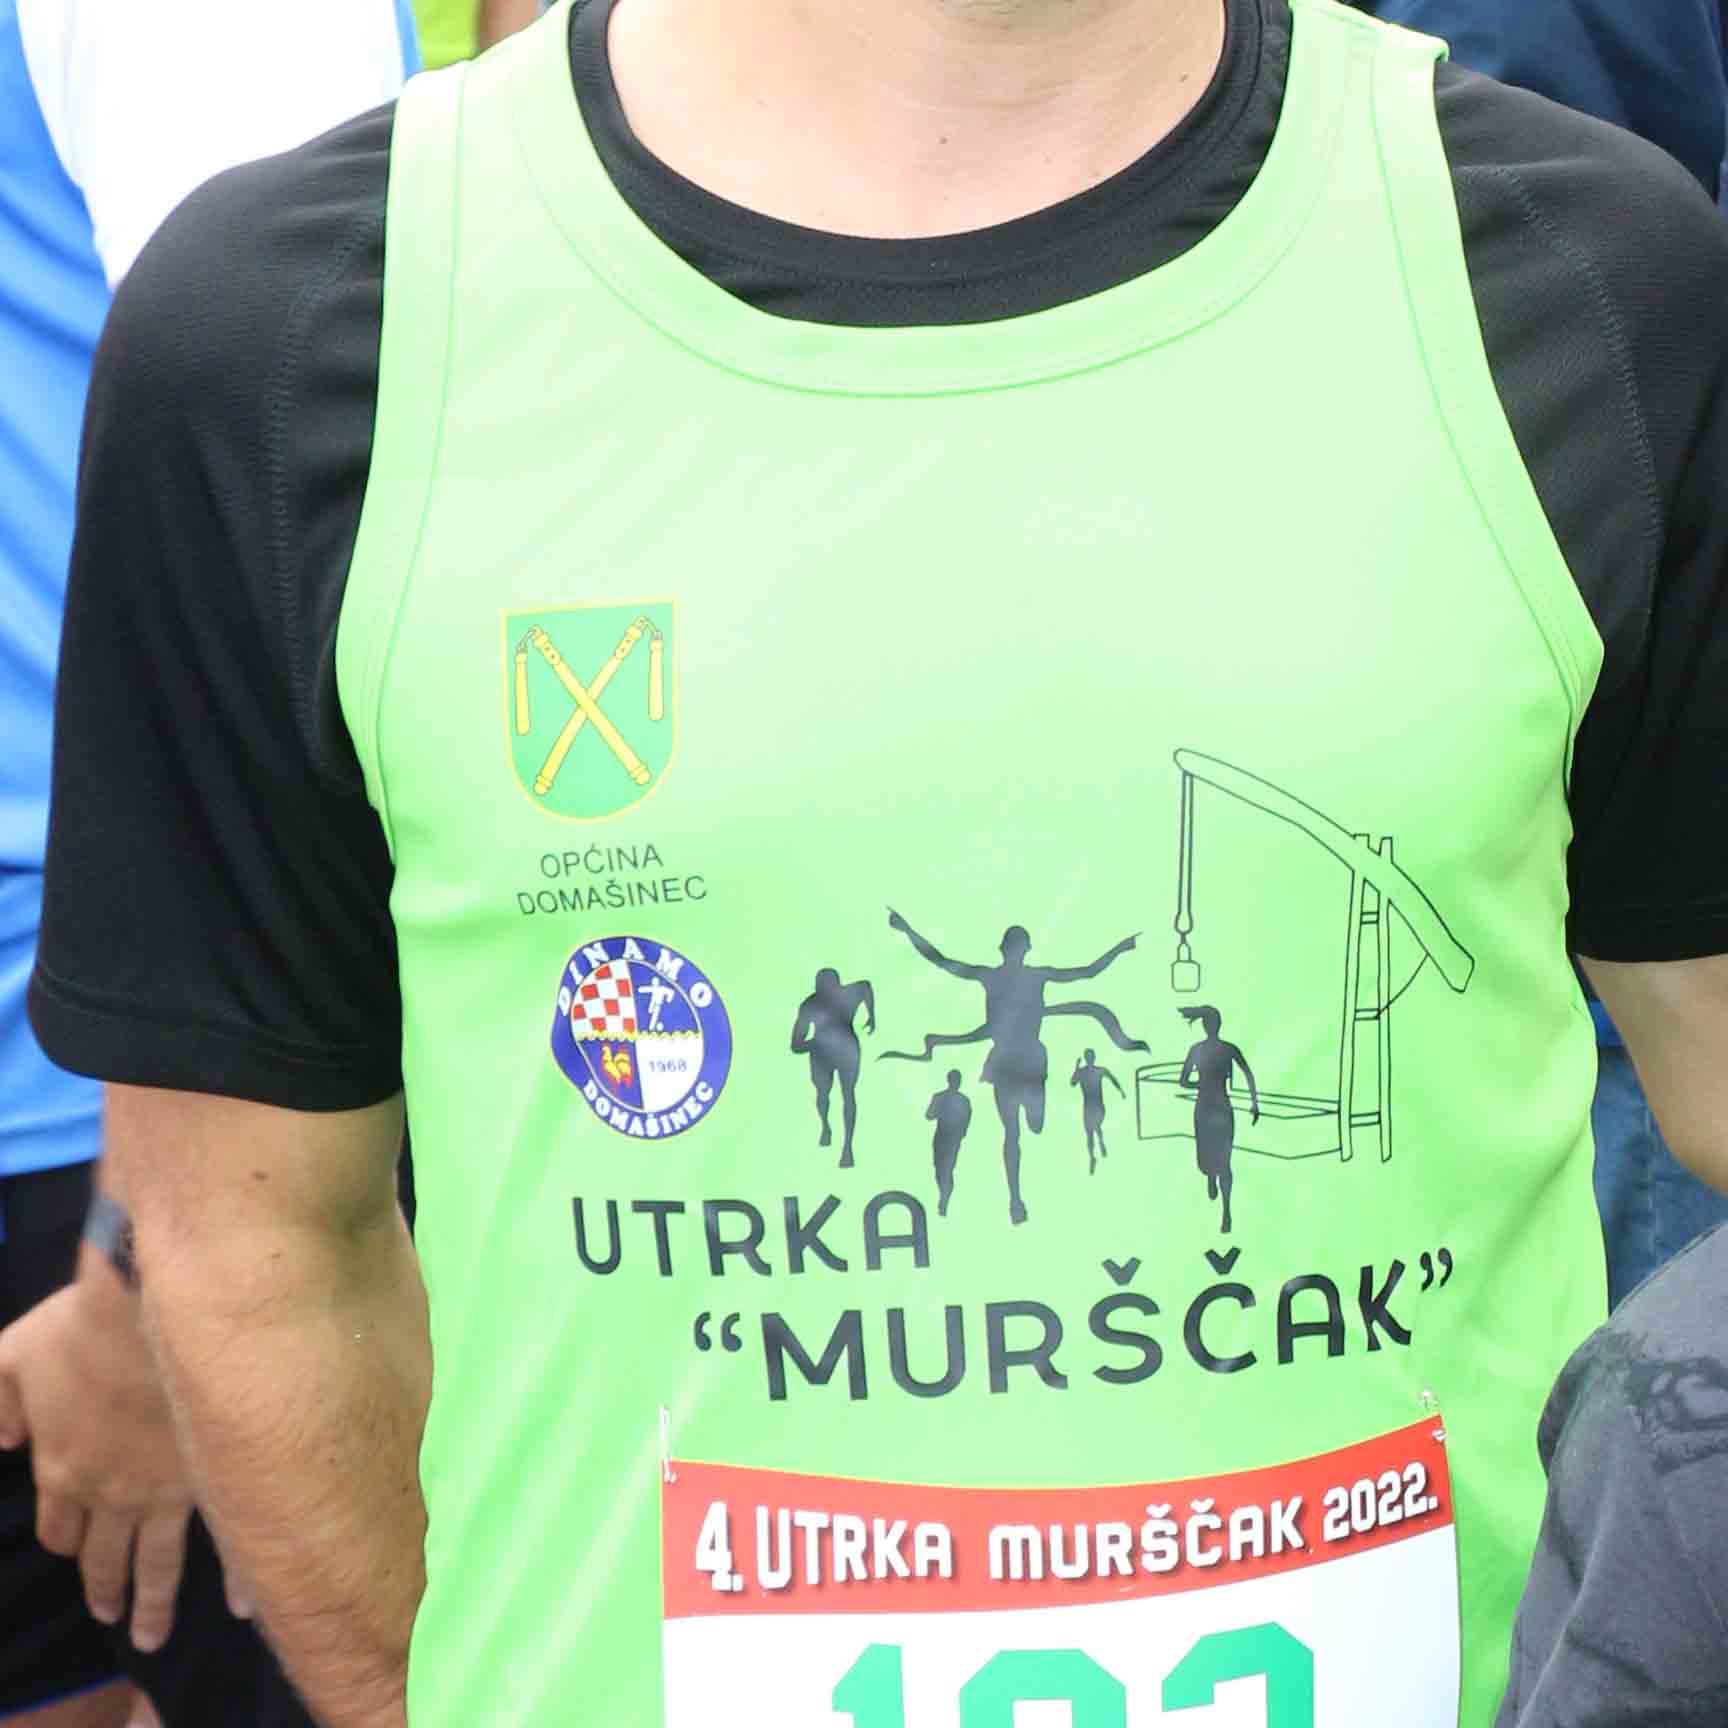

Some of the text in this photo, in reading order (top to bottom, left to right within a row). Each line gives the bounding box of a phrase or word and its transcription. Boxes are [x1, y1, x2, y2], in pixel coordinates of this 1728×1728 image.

[539, 841, 665, 880] OPĆINA
[517, 873, 709, 917] DOMAŠINEC
[558, 937, 714, 1017] DINAMO
[648, 1058, 688, 1074] 1968
[583, 1079, 714, 1138] DOMAŠINEC
[571, 1189, 931, 1277] UTRKA
[694, 1461, 1440, 1593] 4. UTRKA MURŠČAK 2022.
